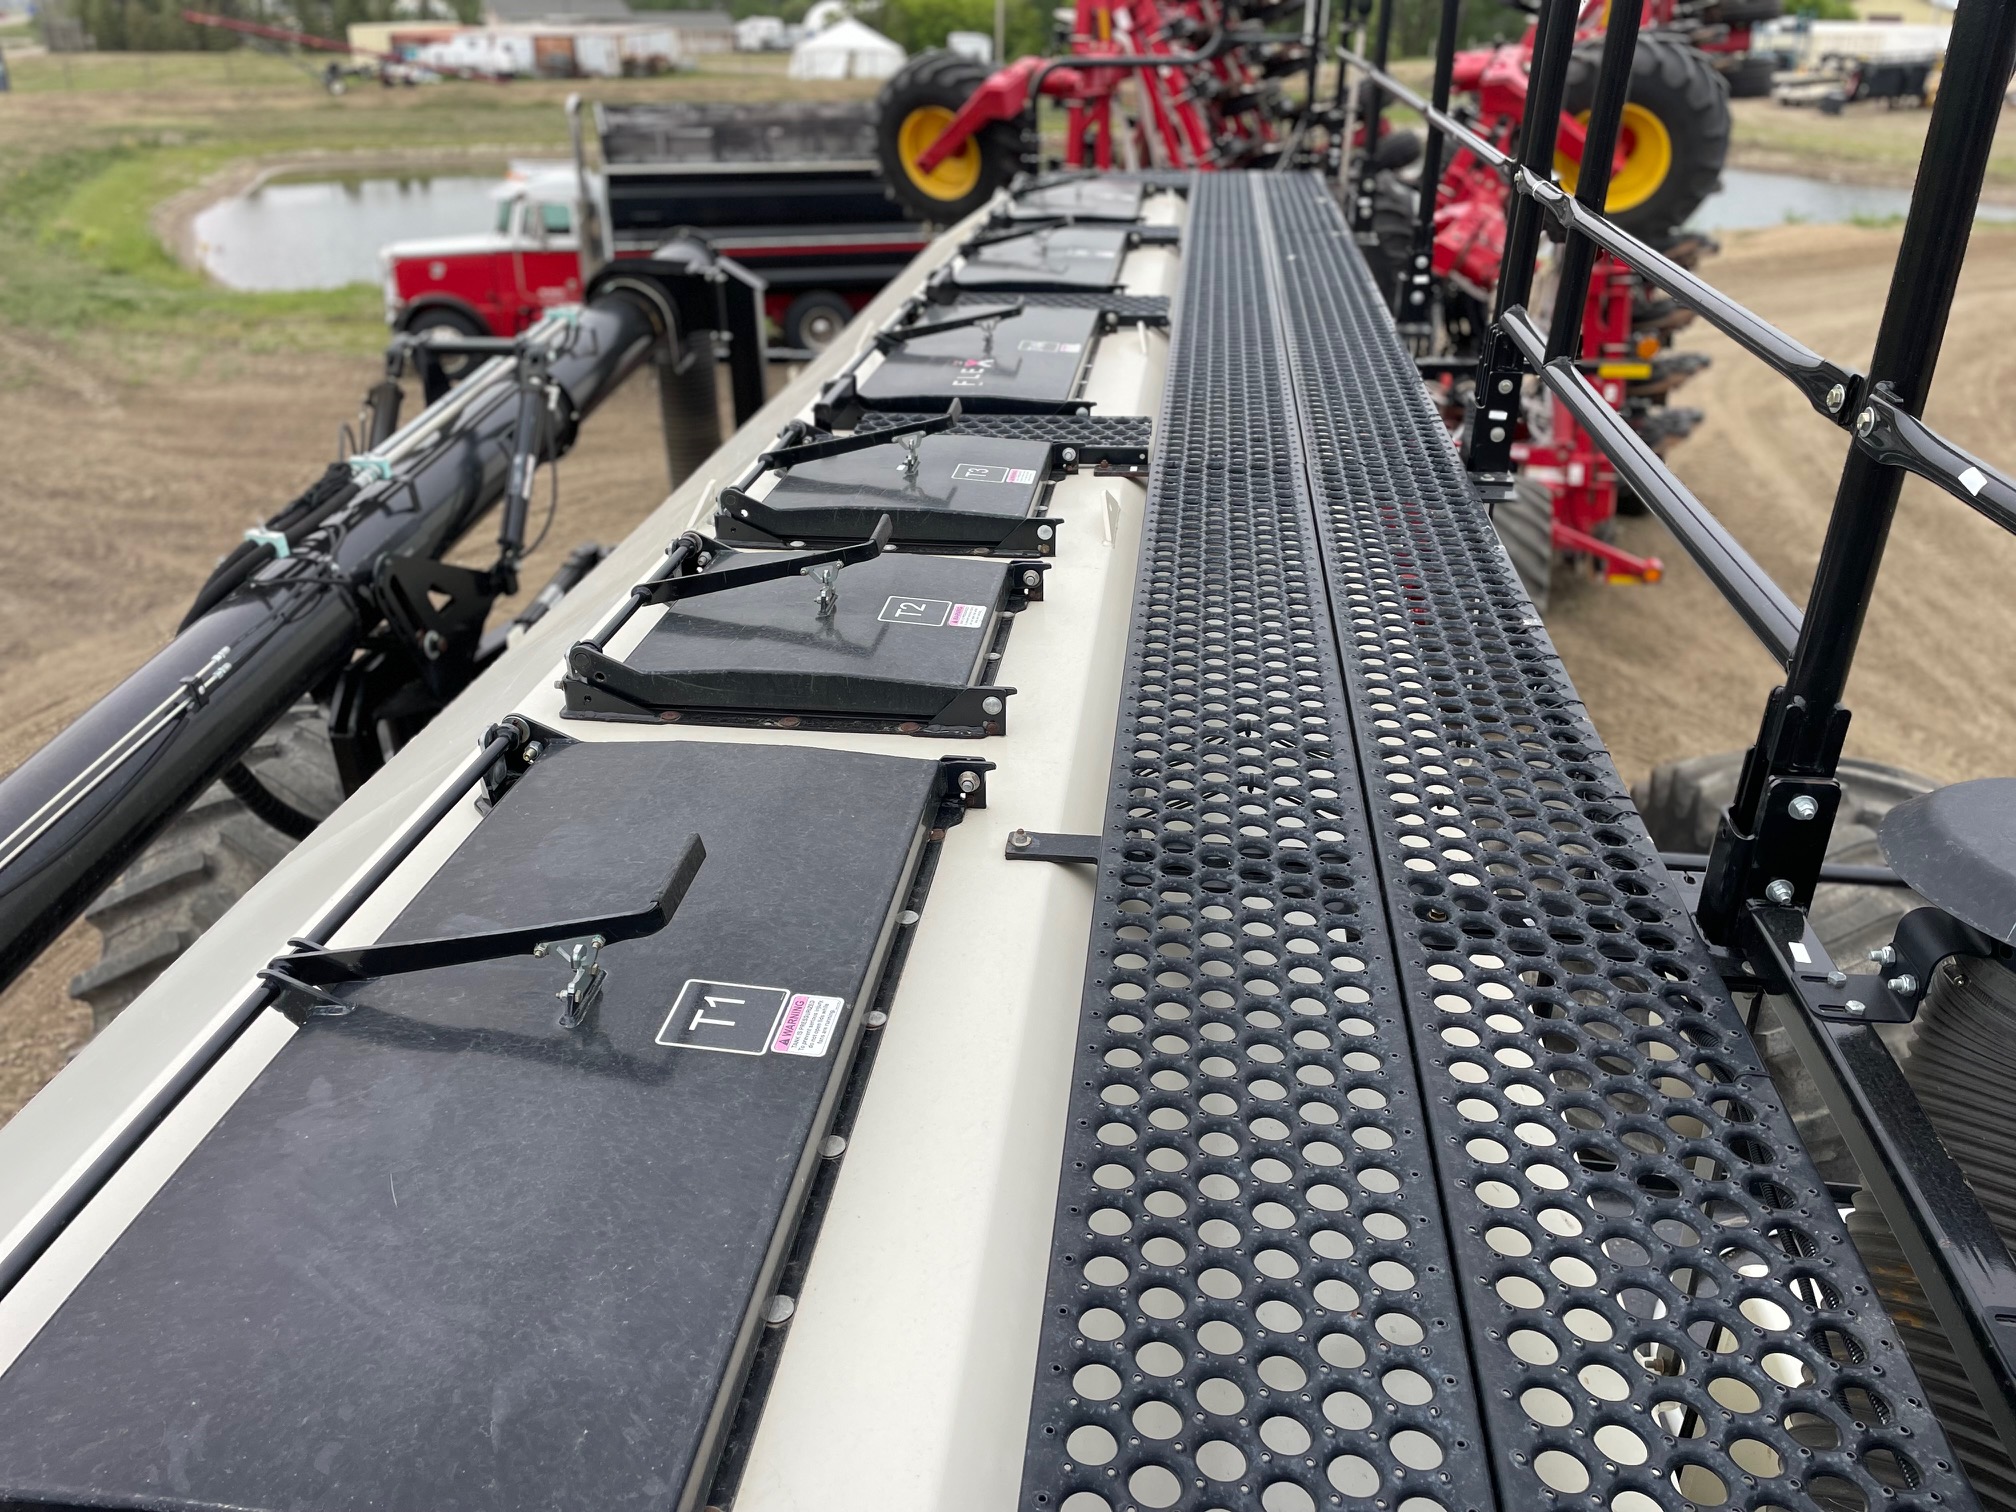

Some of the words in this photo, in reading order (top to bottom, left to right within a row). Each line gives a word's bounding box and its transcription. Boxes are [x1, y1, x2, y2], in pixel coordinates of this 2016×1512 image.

[965, 468, 989, 477] T3
[895, 602, 926, 617] T2
[689, 996, 745, 1030] T1
[782, 1000, 804, 1036] WARNING
[791, 1036, 800, 1048] TANK
[799, 1000, 815, 1030] PRESSURIZED
[802, 1029, 812, 1045] prevent
[809, 1012, 818, 1028] serious
